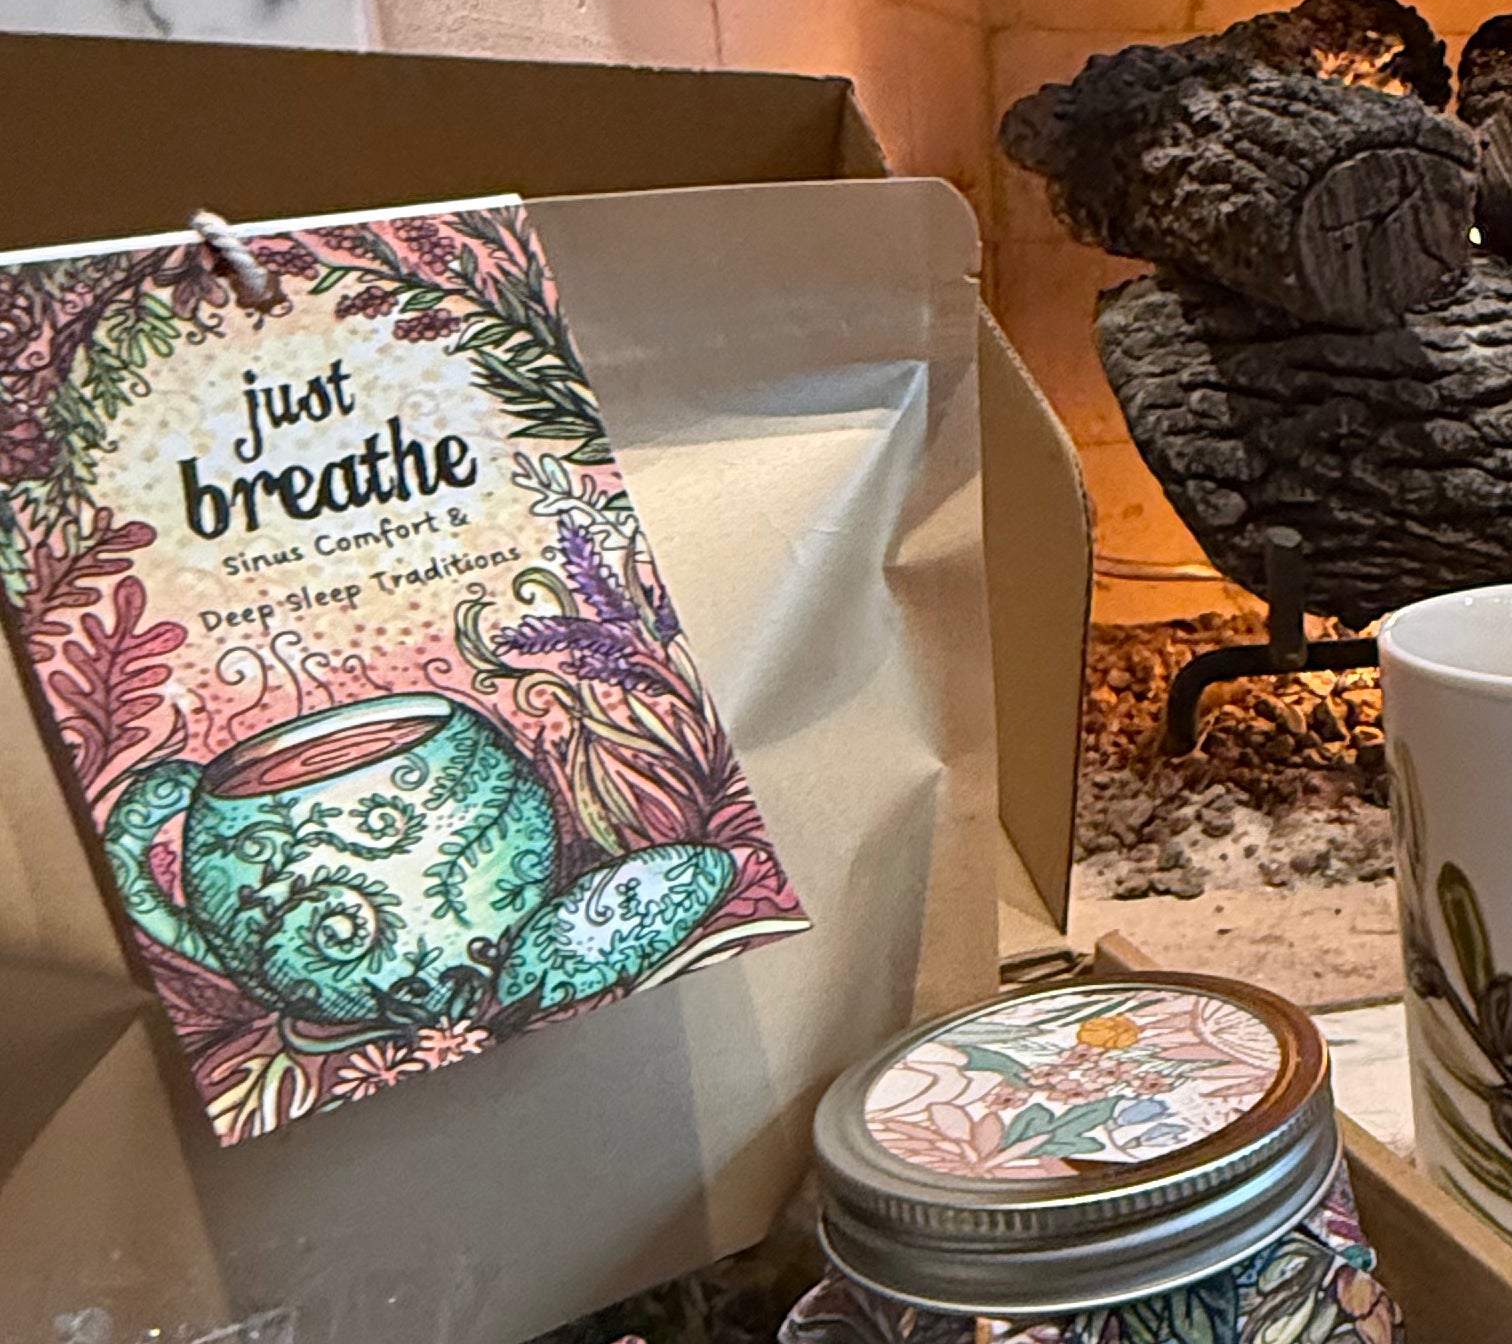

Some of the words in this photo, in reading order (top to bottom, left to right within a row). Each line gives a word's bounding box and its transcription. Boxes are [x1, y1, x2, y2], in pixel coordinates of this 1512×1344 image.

[234, 359, 355, 463] just
[178, 415, 477, 540] breathe
[223, 546, 304, 576] Sinus
[314, 511, 439, 556] Comfort
[447, 507, 471, 527] &
[200, 604, 274, 632] Deep
[286, 586, 362, 611] Sleep
[369, 547, 522, 592] Traditions
